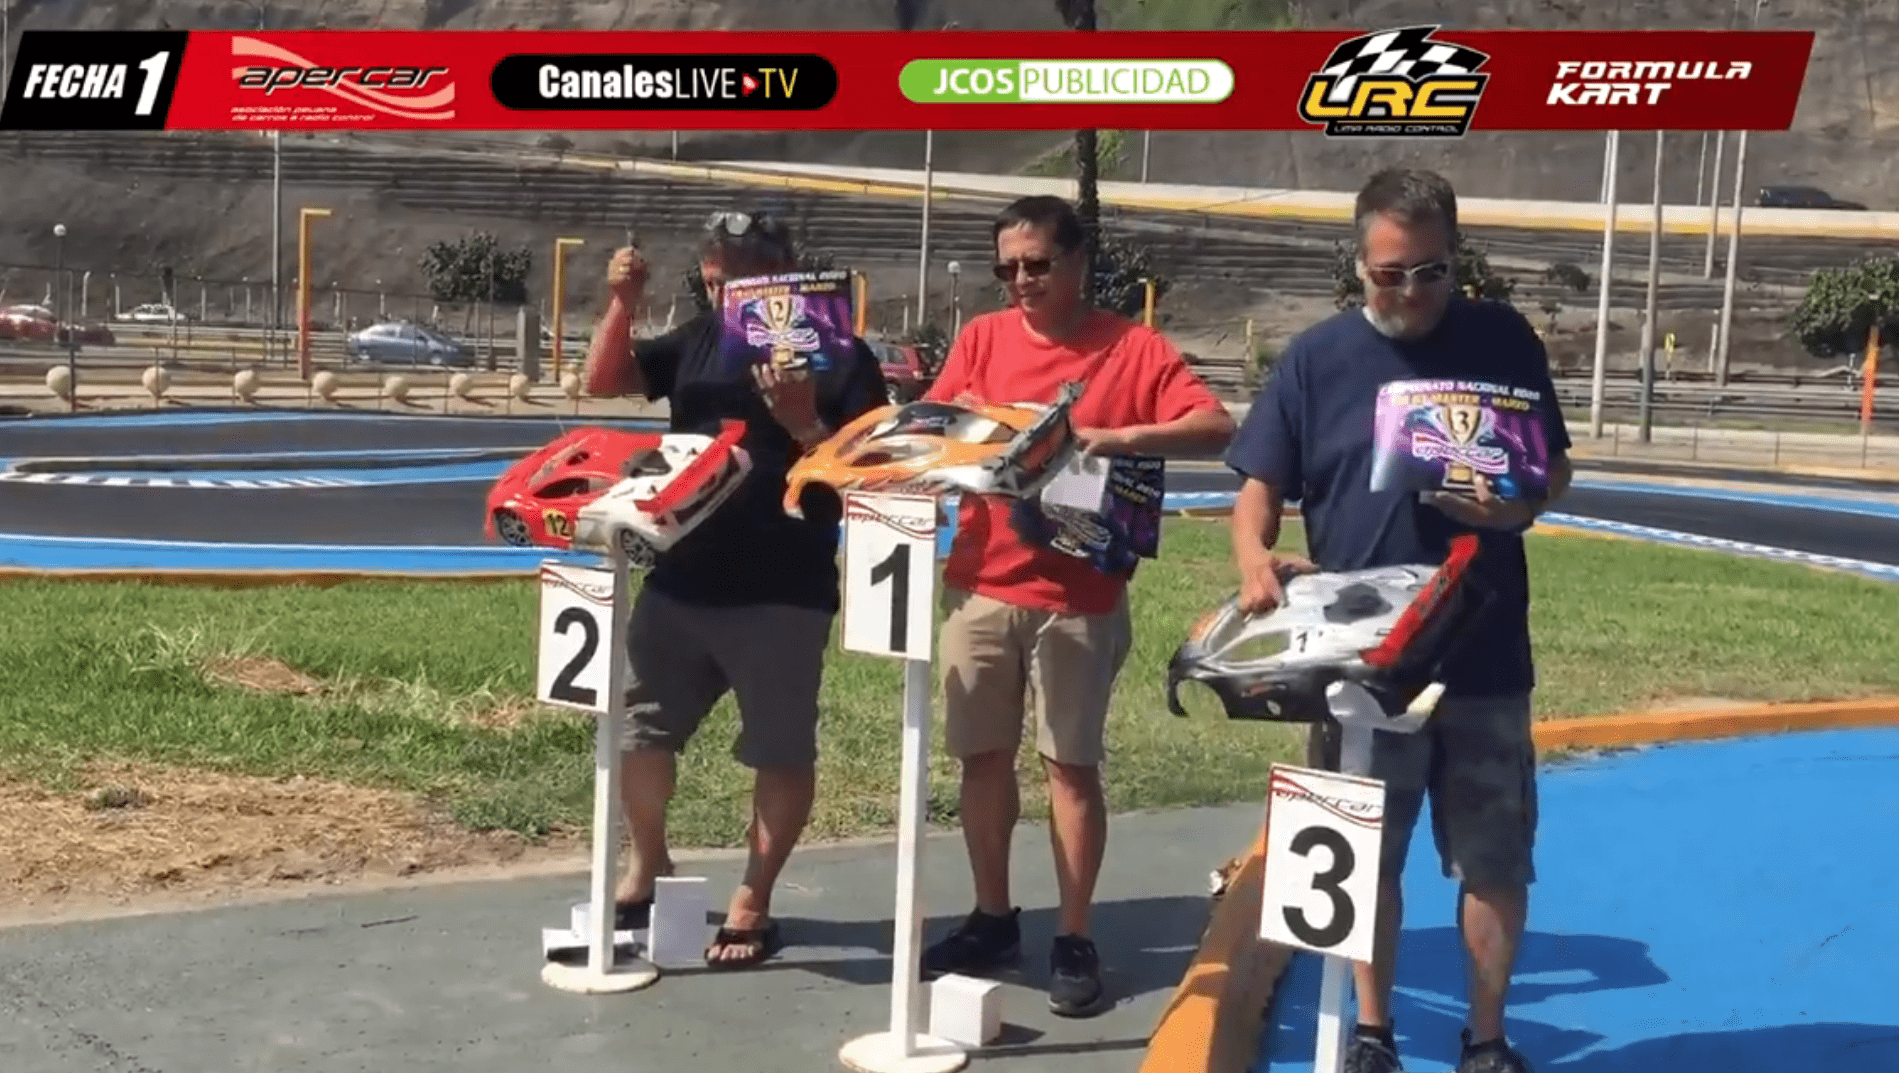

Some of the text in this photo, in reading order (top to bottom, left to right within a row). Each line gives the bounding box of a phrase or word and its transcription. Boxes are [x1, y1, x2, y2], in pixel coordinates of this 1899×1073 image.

[773, 301, 783, 321] 2
[1454, 411, 1470, 434] 3
[546, 513, 574, 537] 12
[871, 543, 911, 653] 1
[549, 606, 600, 707] 2
[1282, 825, 1357, 948] 3
